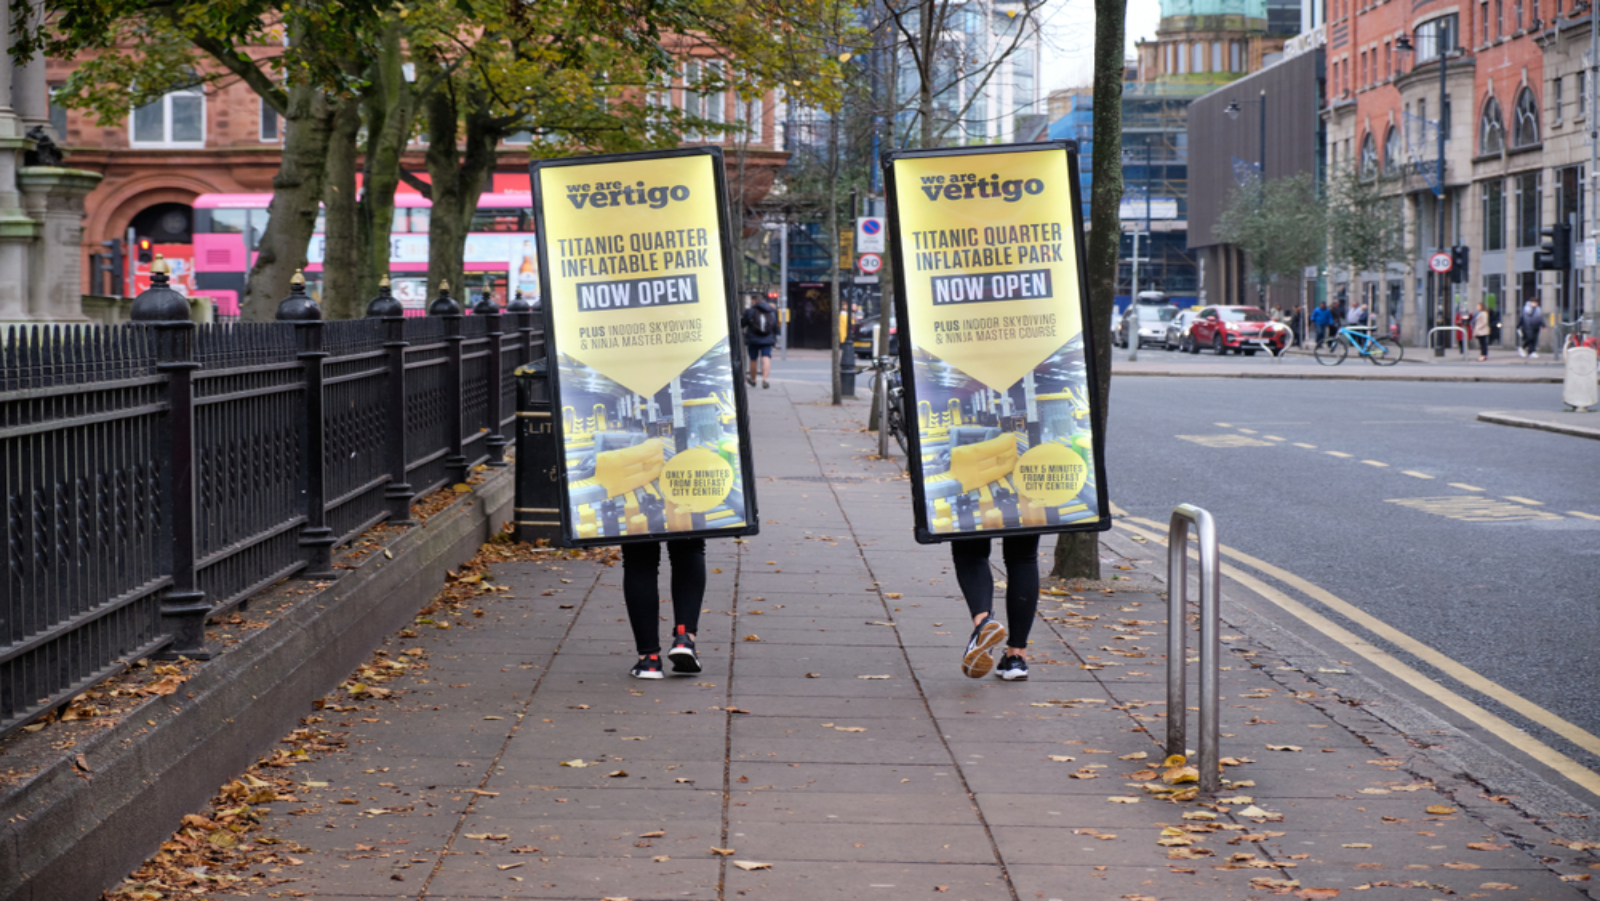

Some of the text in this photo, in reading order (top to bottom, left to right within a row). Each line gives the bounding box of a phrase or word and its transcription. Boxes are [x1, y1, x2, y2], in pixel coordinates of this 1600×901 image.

[566, 181, 622, 192] we are
[920, 173, 977, 184] we are
[922, 174, 1044, 202] vertigo
[567, 181, 690, 209] vertigo
[558, 228, 708, 257] TITANIC QUARTER
[912, 222, 1062, 250] TITANIC QUARTER
[561, 248, 709, 278] INFLATABLE PARK
[862, 258, 879, 267] 30
[916, 243, 1063, 271] INFLATABLE PARK
[1434, 258, 1450, 267] 30
[581, 277, 693, 309] NOW OPEN
[935, 272, 1046, 302] NOW OPEN
[579, 318, 702, 338] PLUS INDOOR SKYDIVING
[934, 313, 1057, 333] PLUS INDOOR SKYDIVING
[580, 331, 703, 350] & NINJA MASTER COURSE
[936, 326, 1057, 345] & NINJA MASTER COURSE
[665, 469, 730, 479] ONLY 5 MINUTES
[1019, 464, 1083, 474] ONLY 5 MINUTES
[1023, 473, 1079, 482] FROM BELFAST
[669, 478, 726, 488] FROM BELFAST
[672, 487, 724, 497] CITY CENTRE!
[1025, 481, 1078, 491] CITY CENTRE!
